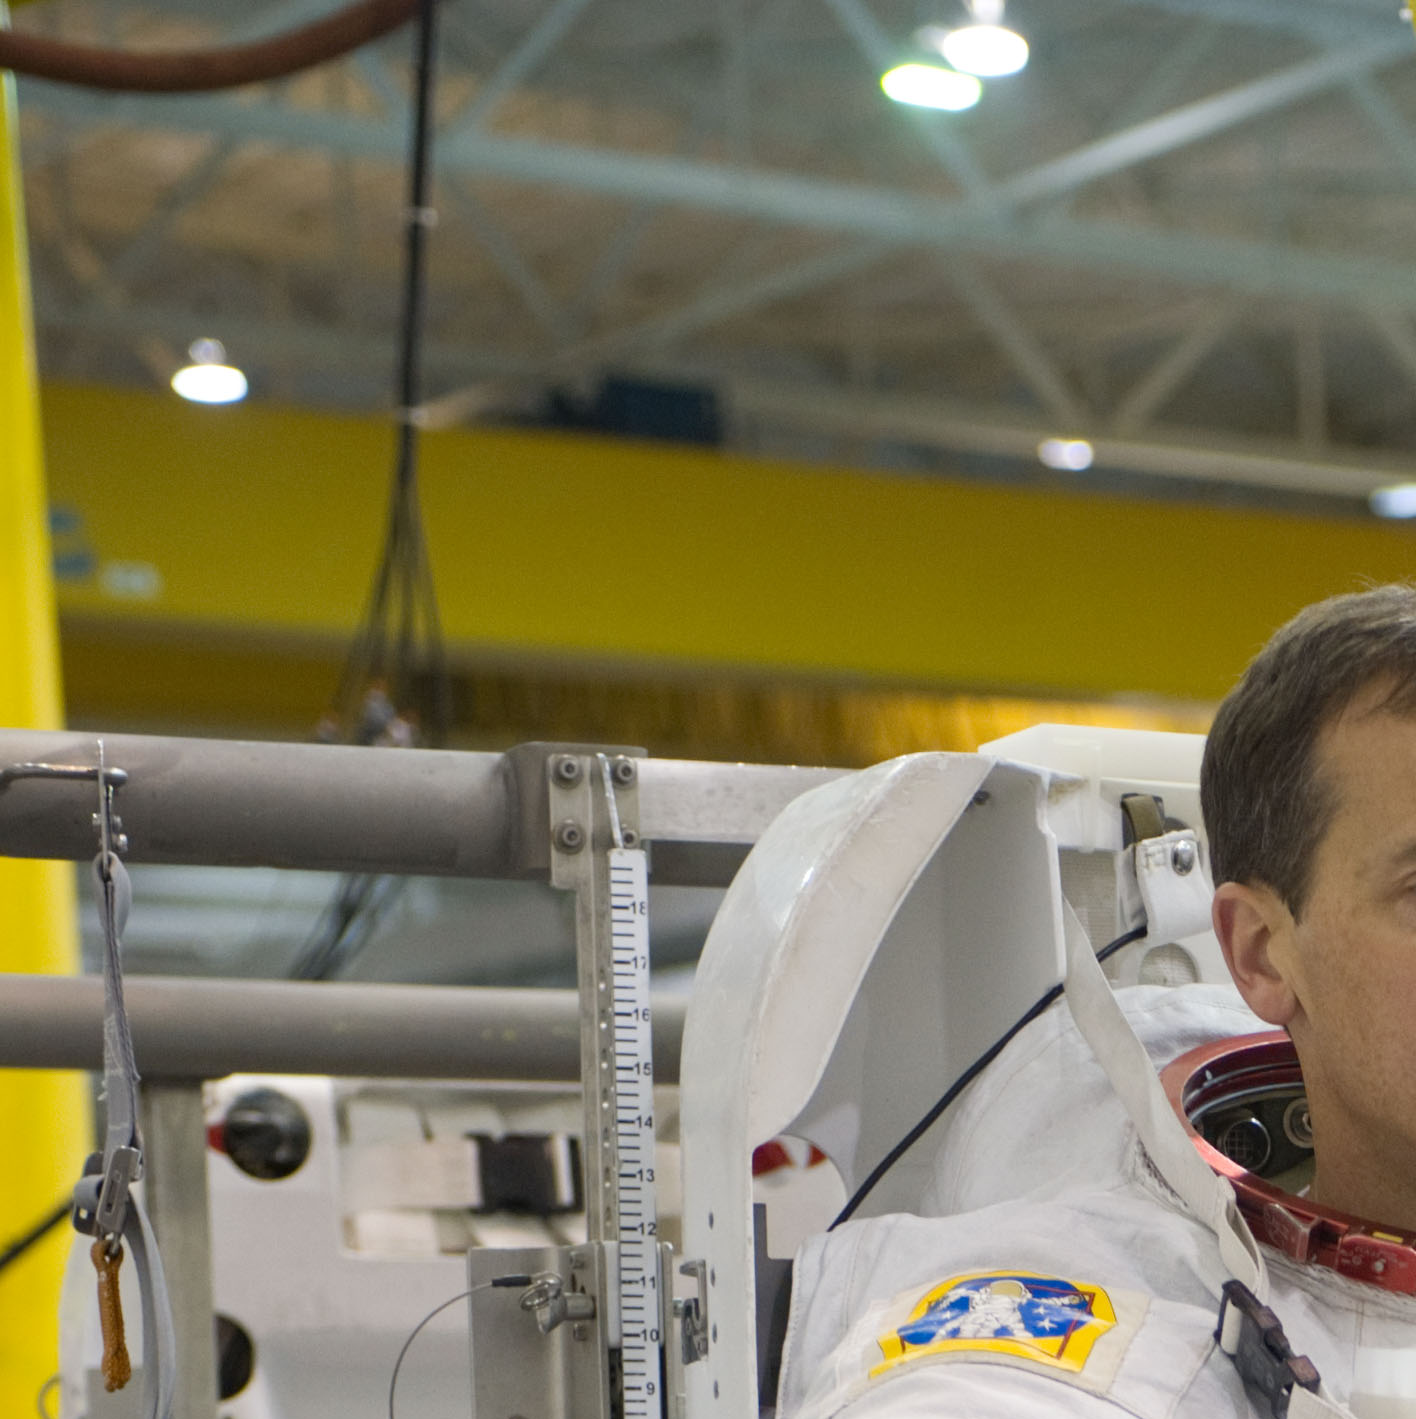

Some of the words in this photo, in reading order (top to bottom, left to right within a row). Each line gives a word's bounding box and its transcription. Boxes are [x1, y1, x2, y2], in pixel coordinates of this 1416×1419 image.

[630, 902, 647, 915] 18
[632, 956, 647, 969] 17
[633, 1008, 650, 1021] 16
[634, 1062, 651, 1076] 15
[635, 1115, 653, 1129] 14
[637, 1169, 655, 1183] 13
[638, 1222, 656, 1236] 12
[640, 1276, 656, 1289] 11
[642, 1329, 659, 1342] 10
[646, 1382, 656, 1395] 9
